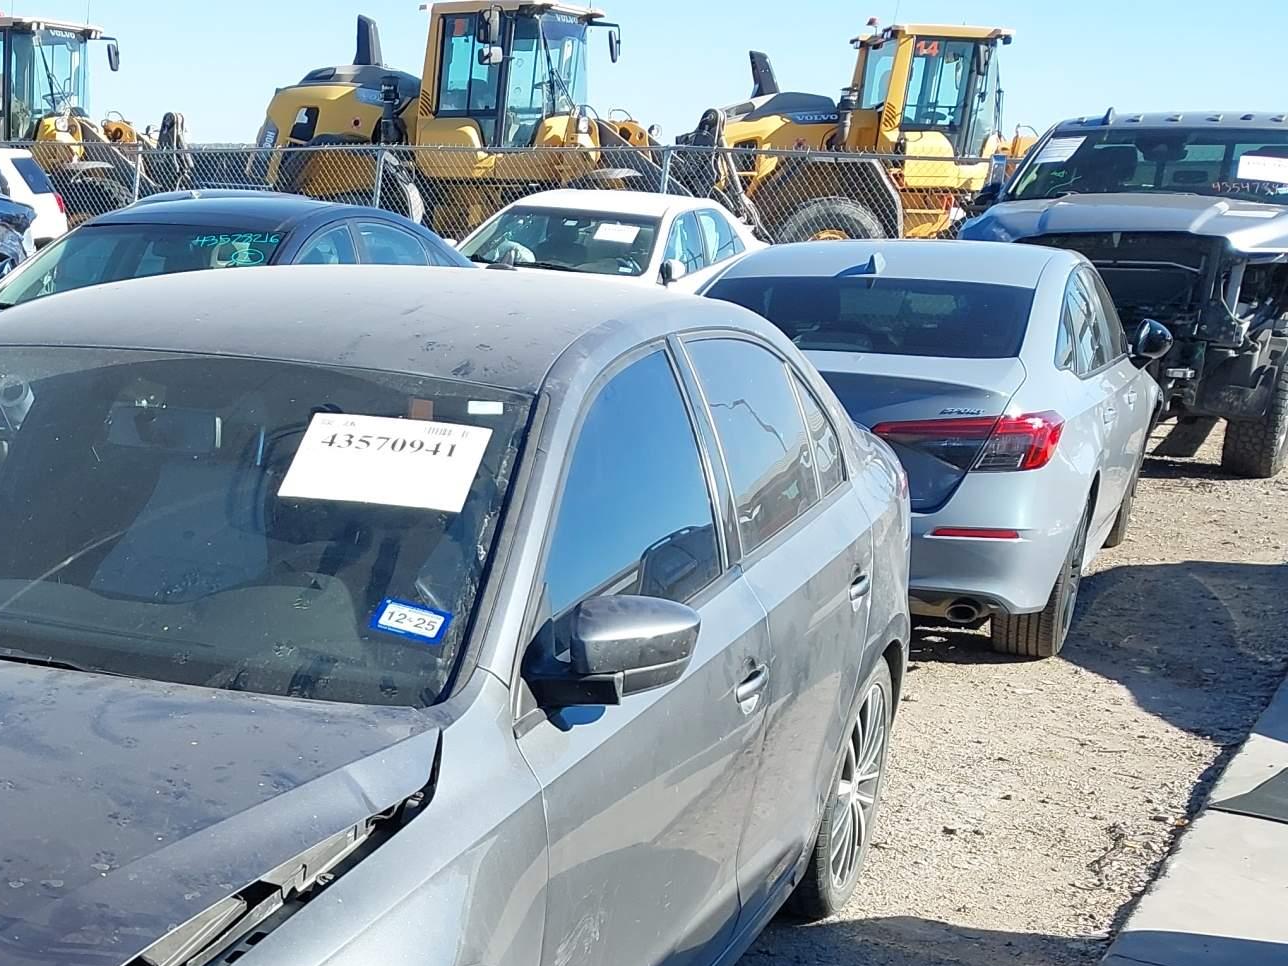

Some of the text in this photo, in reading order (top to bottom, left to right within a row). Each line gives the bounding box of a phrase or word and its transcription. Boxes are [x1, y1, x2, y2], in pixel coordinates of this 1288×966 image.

[49, 29, 76, 39] VOLVO
[916, 40, 939, 56] 14
[320, 432, 457, 457] 43570941
